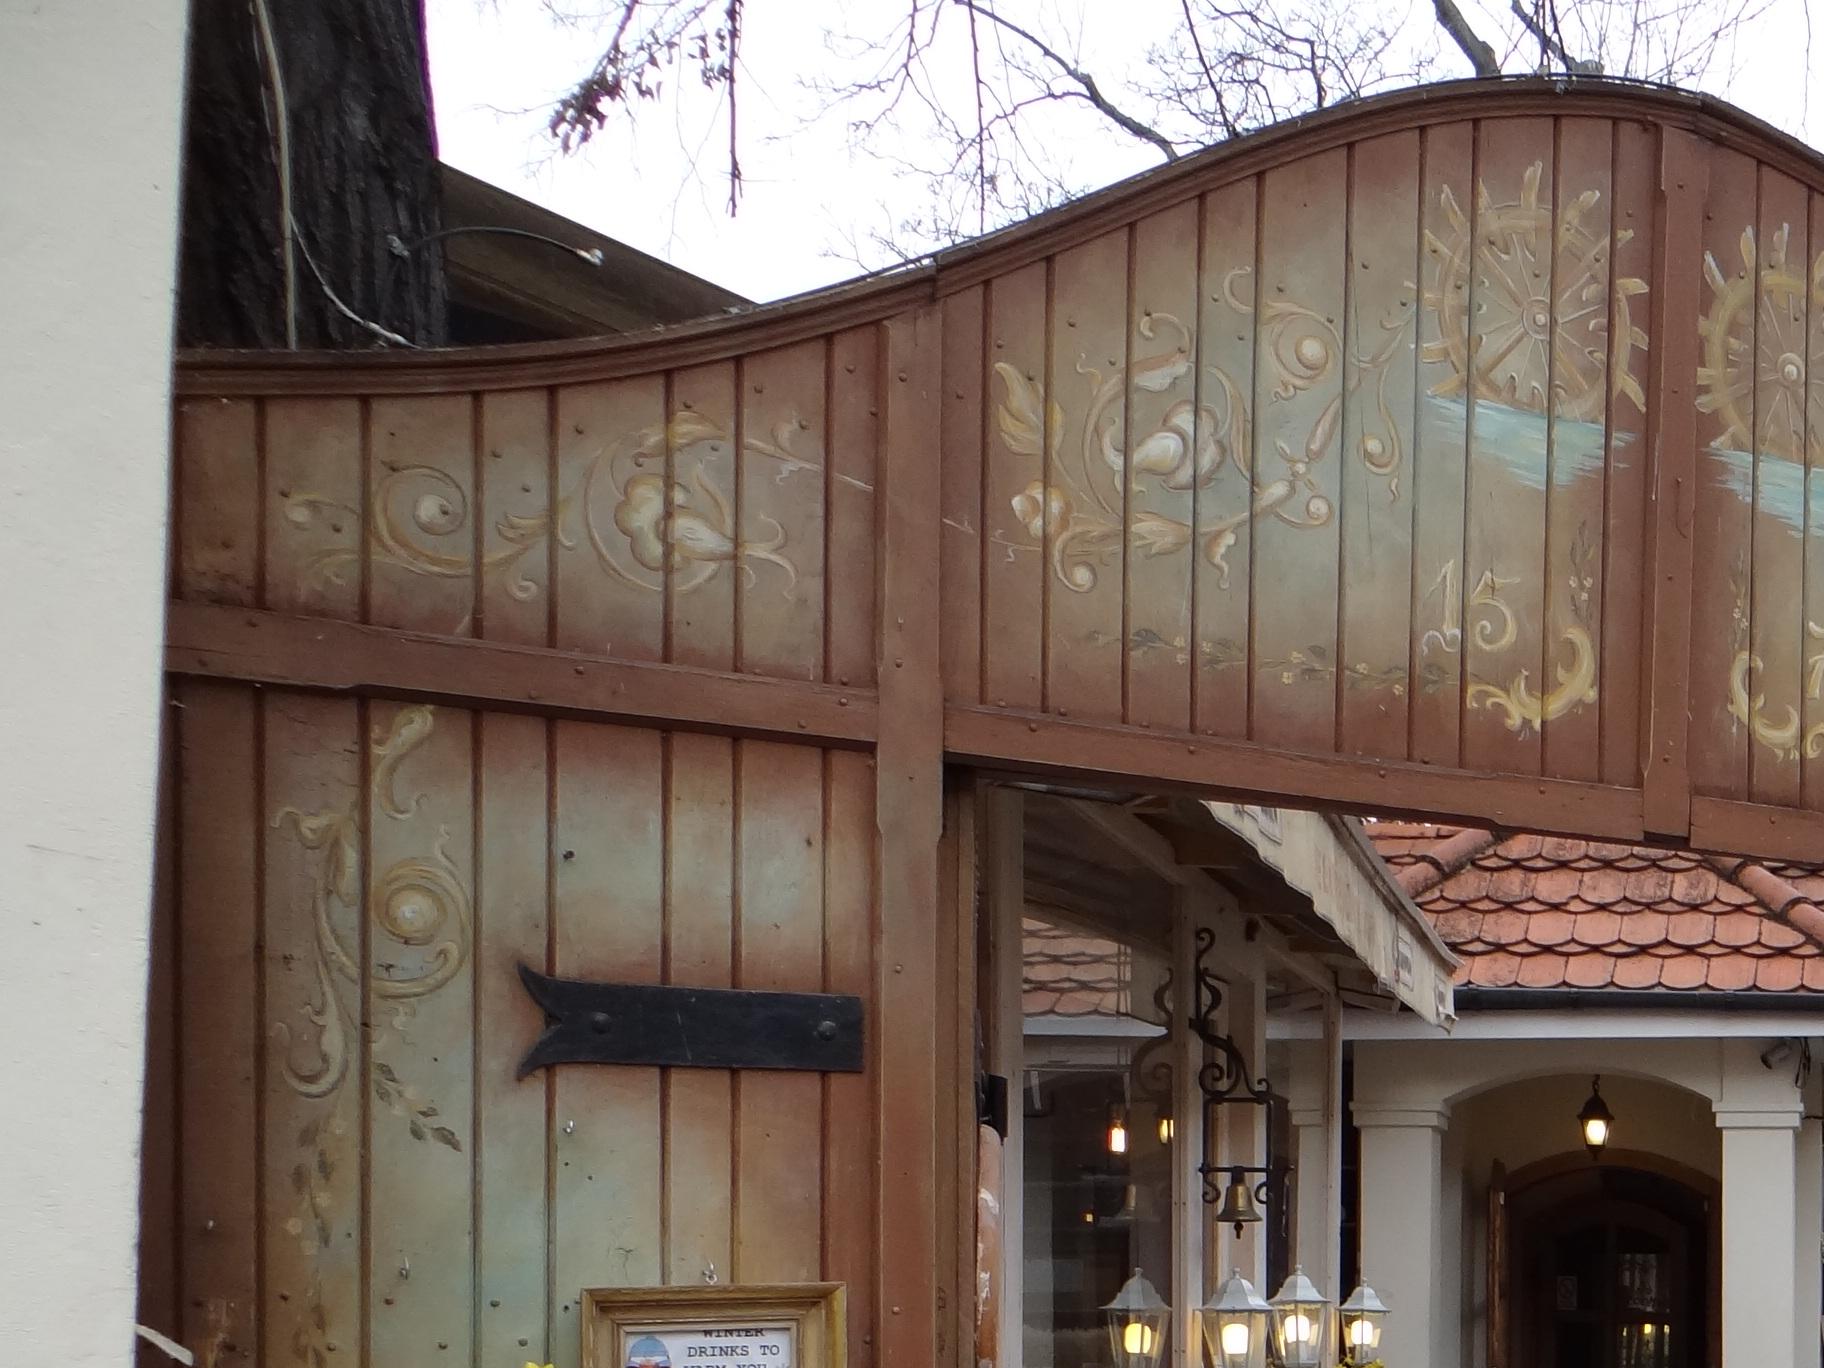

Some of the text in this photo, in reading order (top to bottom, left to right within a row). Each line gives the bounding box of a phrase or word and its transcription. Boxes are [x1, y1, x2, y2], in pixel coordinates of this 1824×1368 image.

[1426, 559, 1520, 652] 15
[702, 1328, 766, 1338] WINTER
[687, 1344, 780, 1357] DRINKS TO
